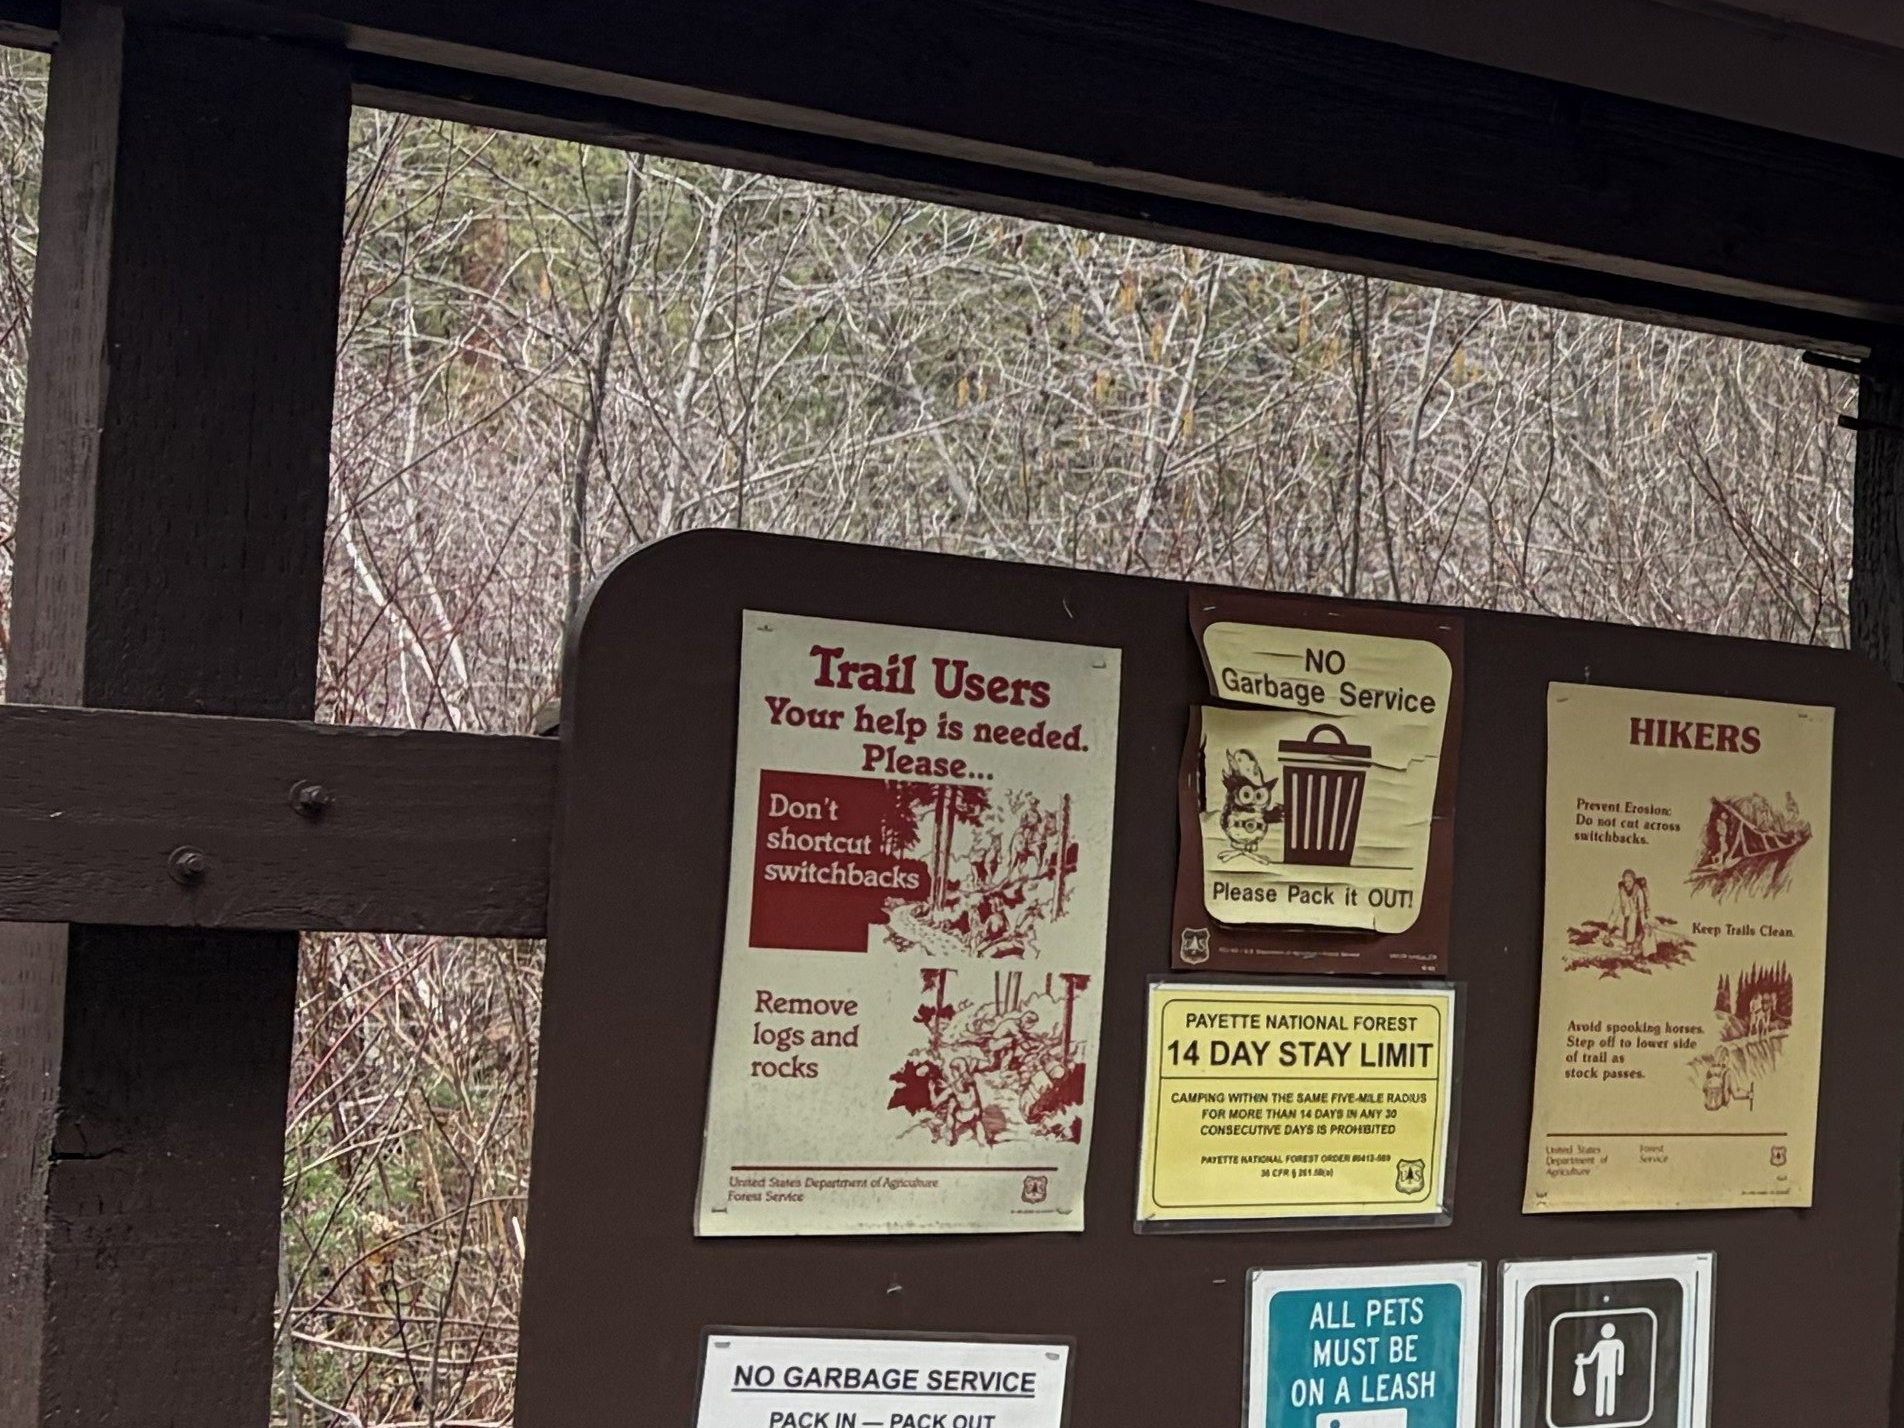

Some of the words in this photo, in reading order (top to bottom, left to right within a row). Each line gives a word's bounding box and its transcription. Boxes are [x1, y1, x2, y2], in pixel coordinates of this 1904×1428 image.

[1305, 648, 1344, 674] NO
[809, 644, 916, 694] Trail
[932, 657, 1049, 708] Users
[1222, 668, 1324, 706] Garbage
[1339, 681, 1435, 713] Service
[764, 695, 844, 729] Your
[853, 703, 926, 744] help
[936, 711, 962, 740] is
[973, 720, 1088, 751] needed.
[1629, 717, 1760, 754] HIKERS
[861, 743, 992, 779] Please...
[769, 793, 837, 820] Don't
[766, 826, 871, 854] shortcut
[764, 861, 918, 888] switchbacks
[1212, 881, 1278, 903] Please
[1288, 884, 1334, 904] Pack
[1345, 887, 1356, 905] it
[1368, 888, 1412, 907] OUT!
[1692, 922, 1720, 936] Keep
[1726, 923, 1755, 935] Trails
[754, 990, 857, 1015] Remove
[1186, 1013, 1260, 1028] PAYETTE
[1266, 1014, 1347, 1030] NATIONAL
[1354, 1016, 1417, 1031] FOREST
[753, 1021, 804, 1051] logs
[810, 1024, 859, 1046] and
[1566, 1035, 1594, 1053] Step
[1599, 1036, 1615, 1048] off
[1620, 1038, 1631, 1047] to
[1636, 1036, 1667, 1048] lower
[1673, 1037, 1696, 1048] side
[751, 1055, 818, 1077] rocks
[1168, 1040, 1199, 1065] 14
[1210, 1040, 1270, 1065] DAY
[1279, 1041, 1351, 1066] STAY
[1361, 1042, 1433, 1067] LIMIT
[1200, 1124, 1280, 1135] CONSECUTIVE
[1284, 1124, 1313, 1135] DAYS
[1317, 1124, 1326, 1134] IS
[1330, 1124, 1395, 1134] PROHIBITED
[727, 1190, 760, 1201] Forest
[766, 1190, 803, 1201] Service
[729, 1176, 764, 1187] United
[770, 1177, 800, 1187] States
[805, 1177, 866, 1190] Department
[871, 1176, 881, 1187] of
[883, 1177, 937, 1190] Agriculture
[1309, 1300, 1355, 1329] ALL
[1366, 1297, 1423, 1326] PETS
[1313, 1337, 1379, 1367] MUST
[1389, 1334, 1417, 1362] BE
[734, 1365, 774, 1386] NO
[784, 1366, 918, 1389] GARBAGE
[926, 1369, 1035, 1392] SERVICE
[1291, 1378, 1323, 1406] ON
[1334, 1376, 1349, 1404] A
[1362, 1371, 1434, 1402] LEASH
[769, 1411, 827, 1428] PACK
[836, 1412, 854, 1428] IN
